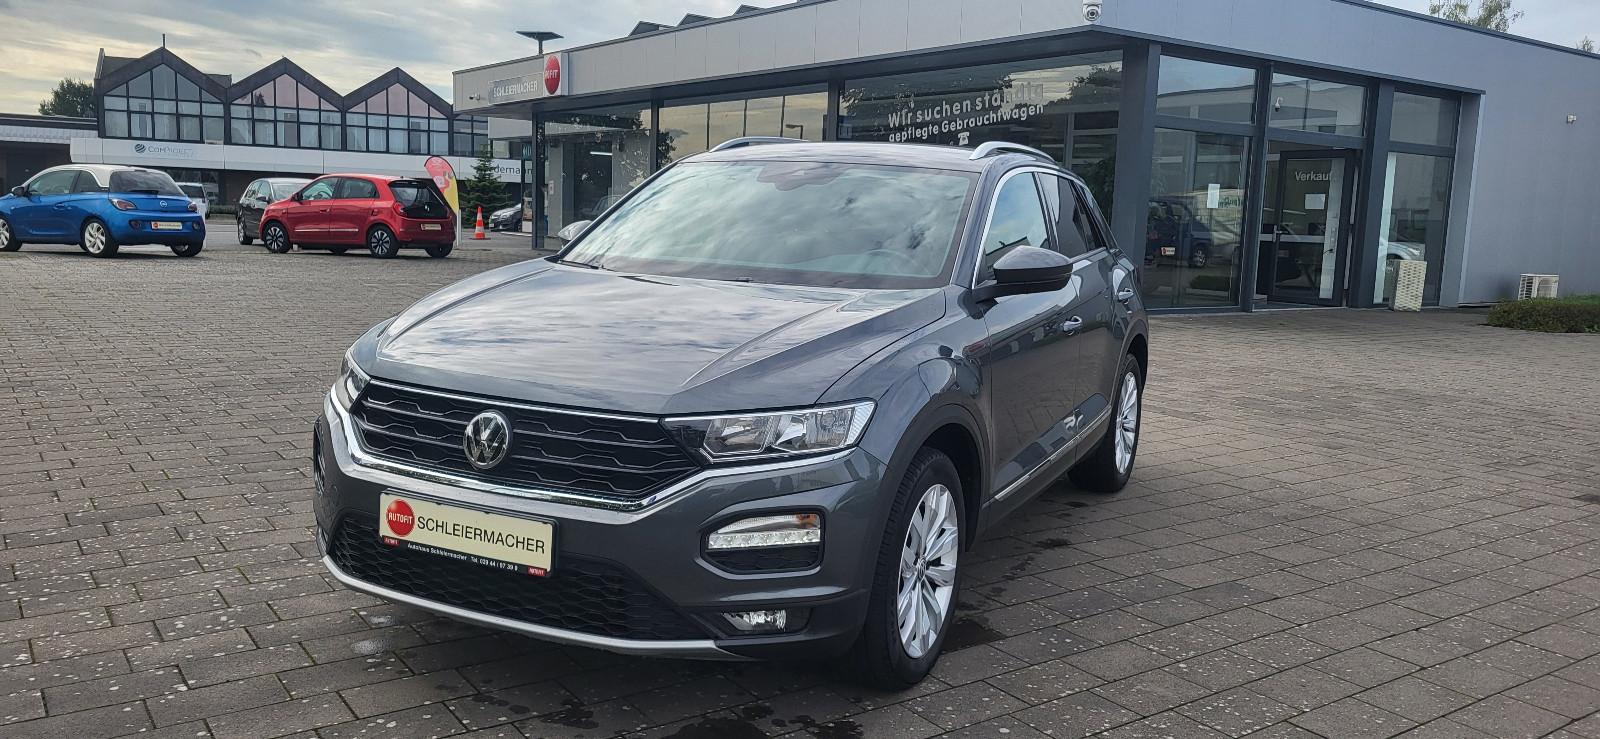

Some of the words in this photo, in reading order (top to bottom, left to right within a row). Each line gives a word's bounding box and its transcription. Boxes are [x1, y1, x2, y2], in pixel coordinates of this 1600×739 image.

[888, 109, 913, 128] Wir
[916, 100, 971, 123] suchen
[941, 104, 1044, 133] Gebrauchtwagen
[388, 511, 413, 525] AUTOFIT
[417, 515, 545, 555] SCHLEIERMACHER
